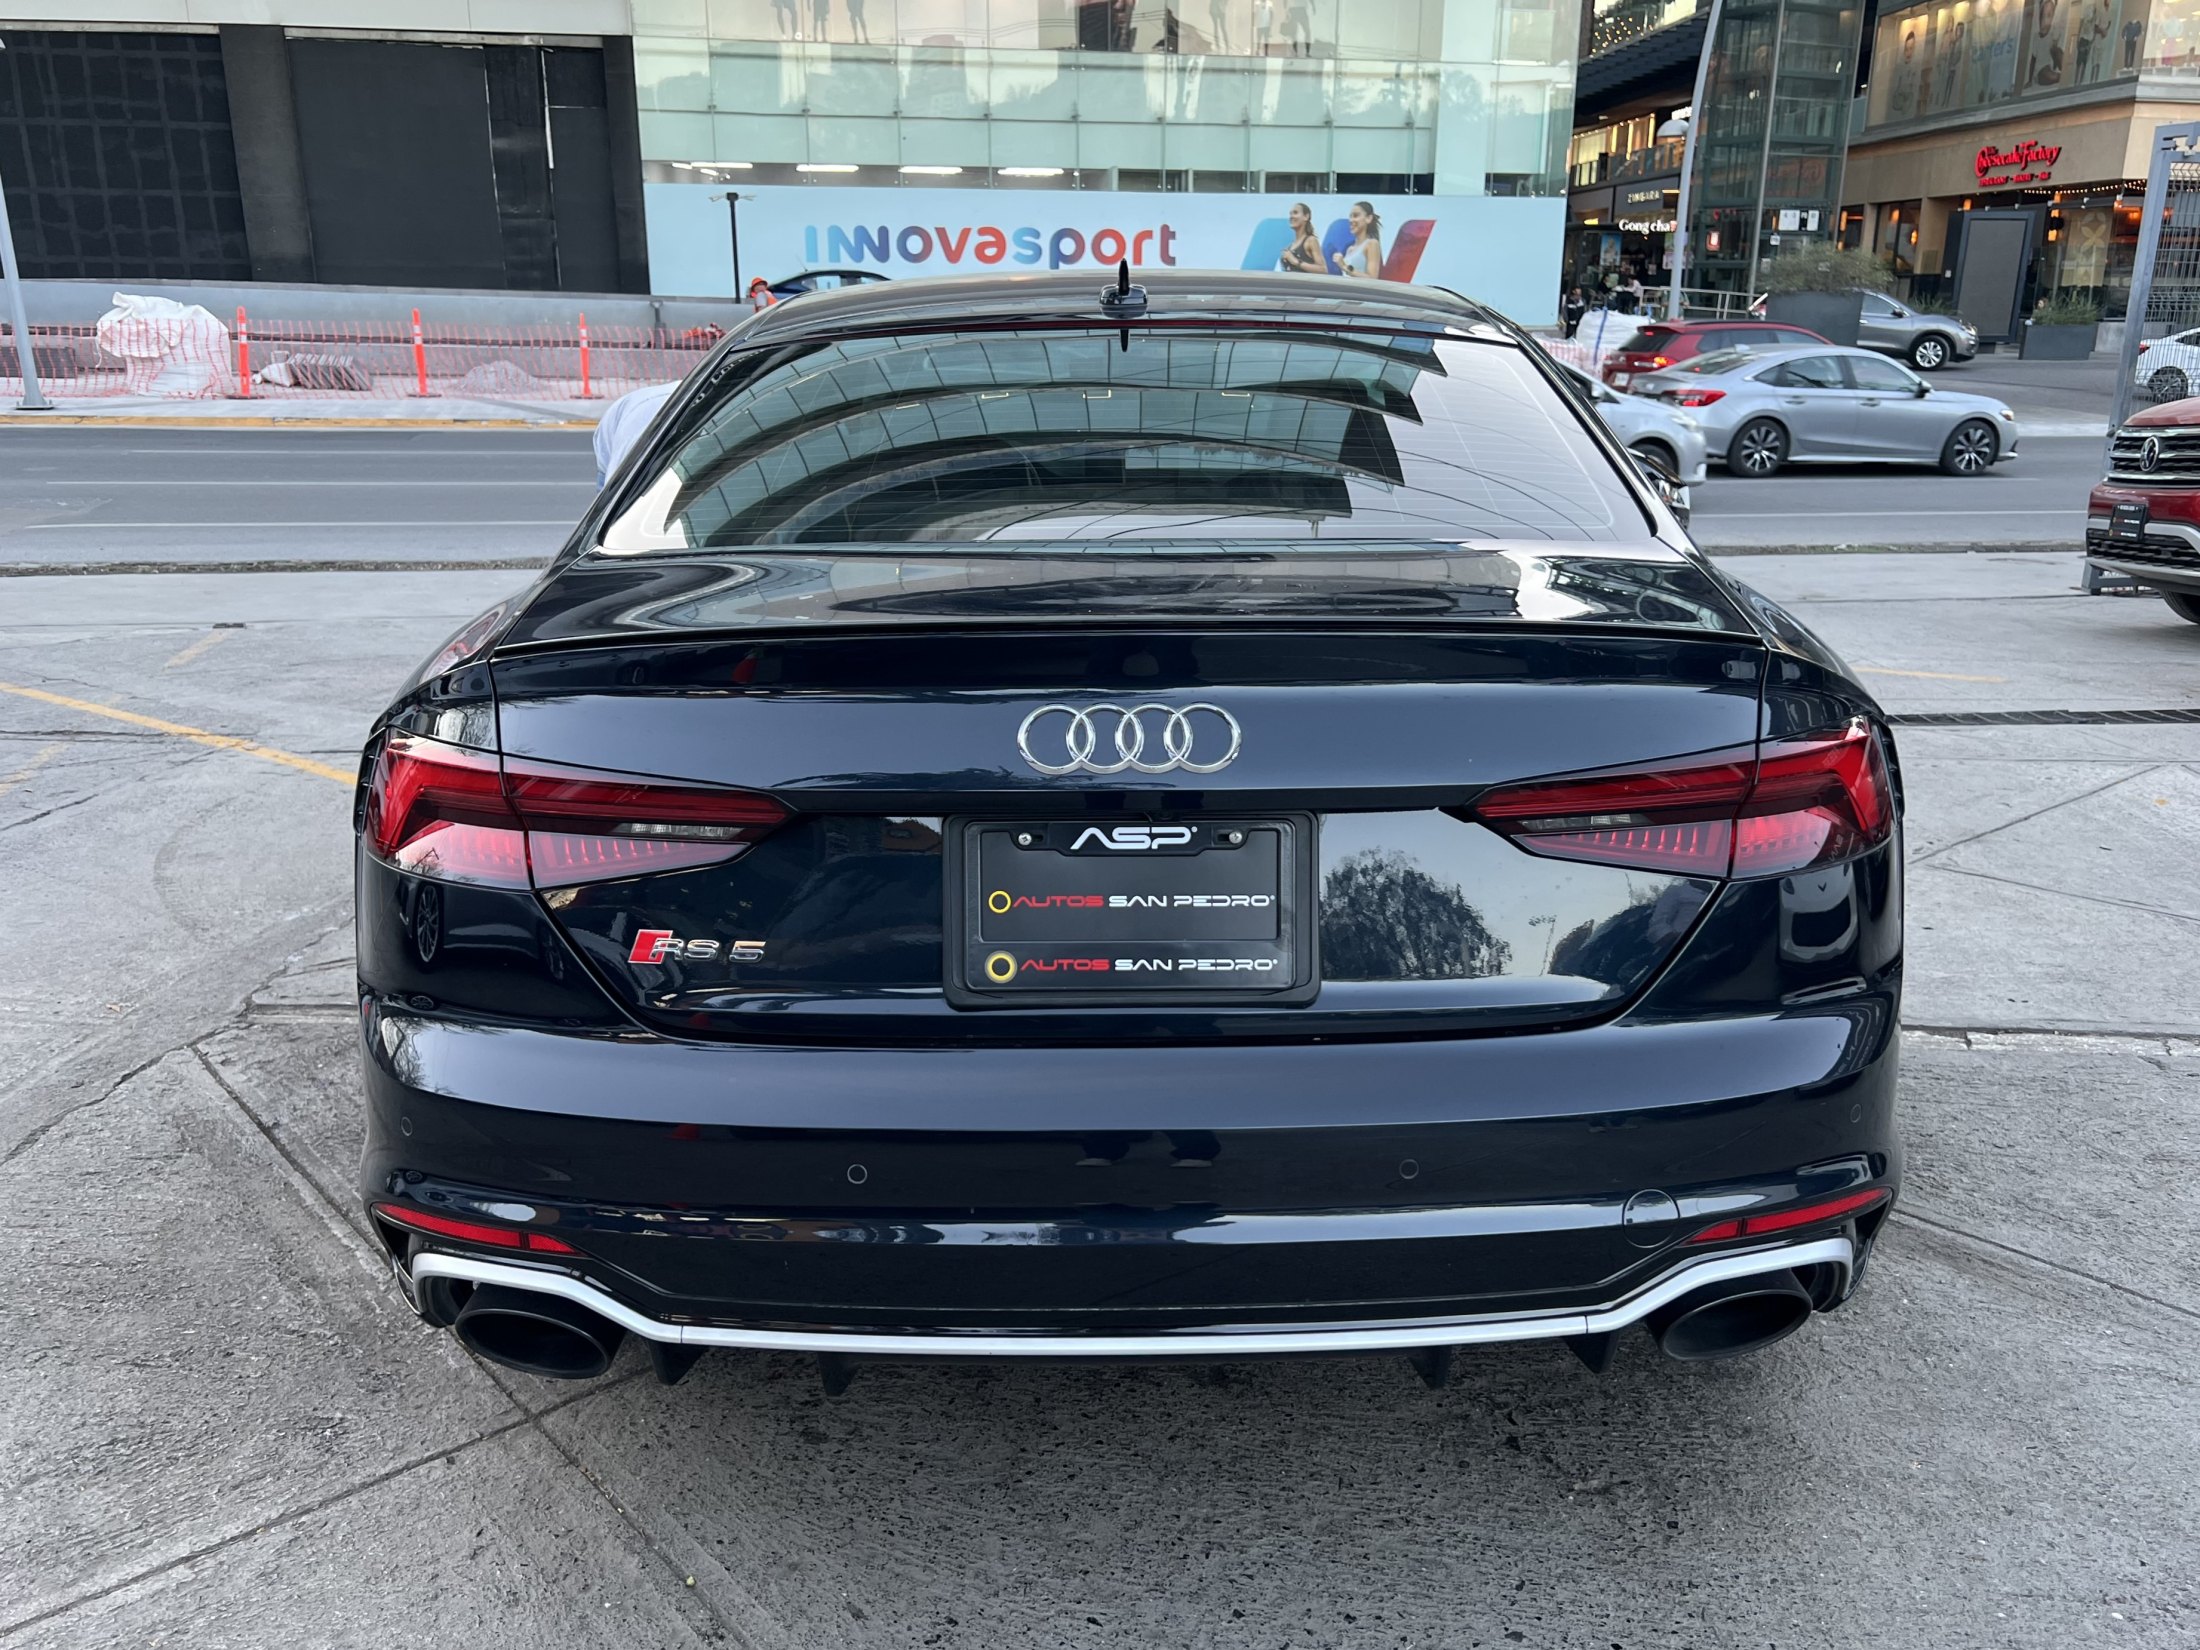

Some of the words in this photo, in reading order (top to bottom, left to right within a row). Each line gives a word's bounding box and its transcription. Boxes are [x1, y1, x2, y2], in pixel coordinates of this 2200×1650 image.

[1618, 218, 1650, 235] Gong
[1650, 219, 1671, 232] cha
[1013, 895, 1104, 907] AUTOS
[1108, 895, 1167, 907] SAN
[1173, 895, 1270, 907] PEDRO
[1020, 959, 1110, 971] AUTOS
[1114, 959, 1172, 971] SAN
[1178, 959, 1272, 971] PEDRO
